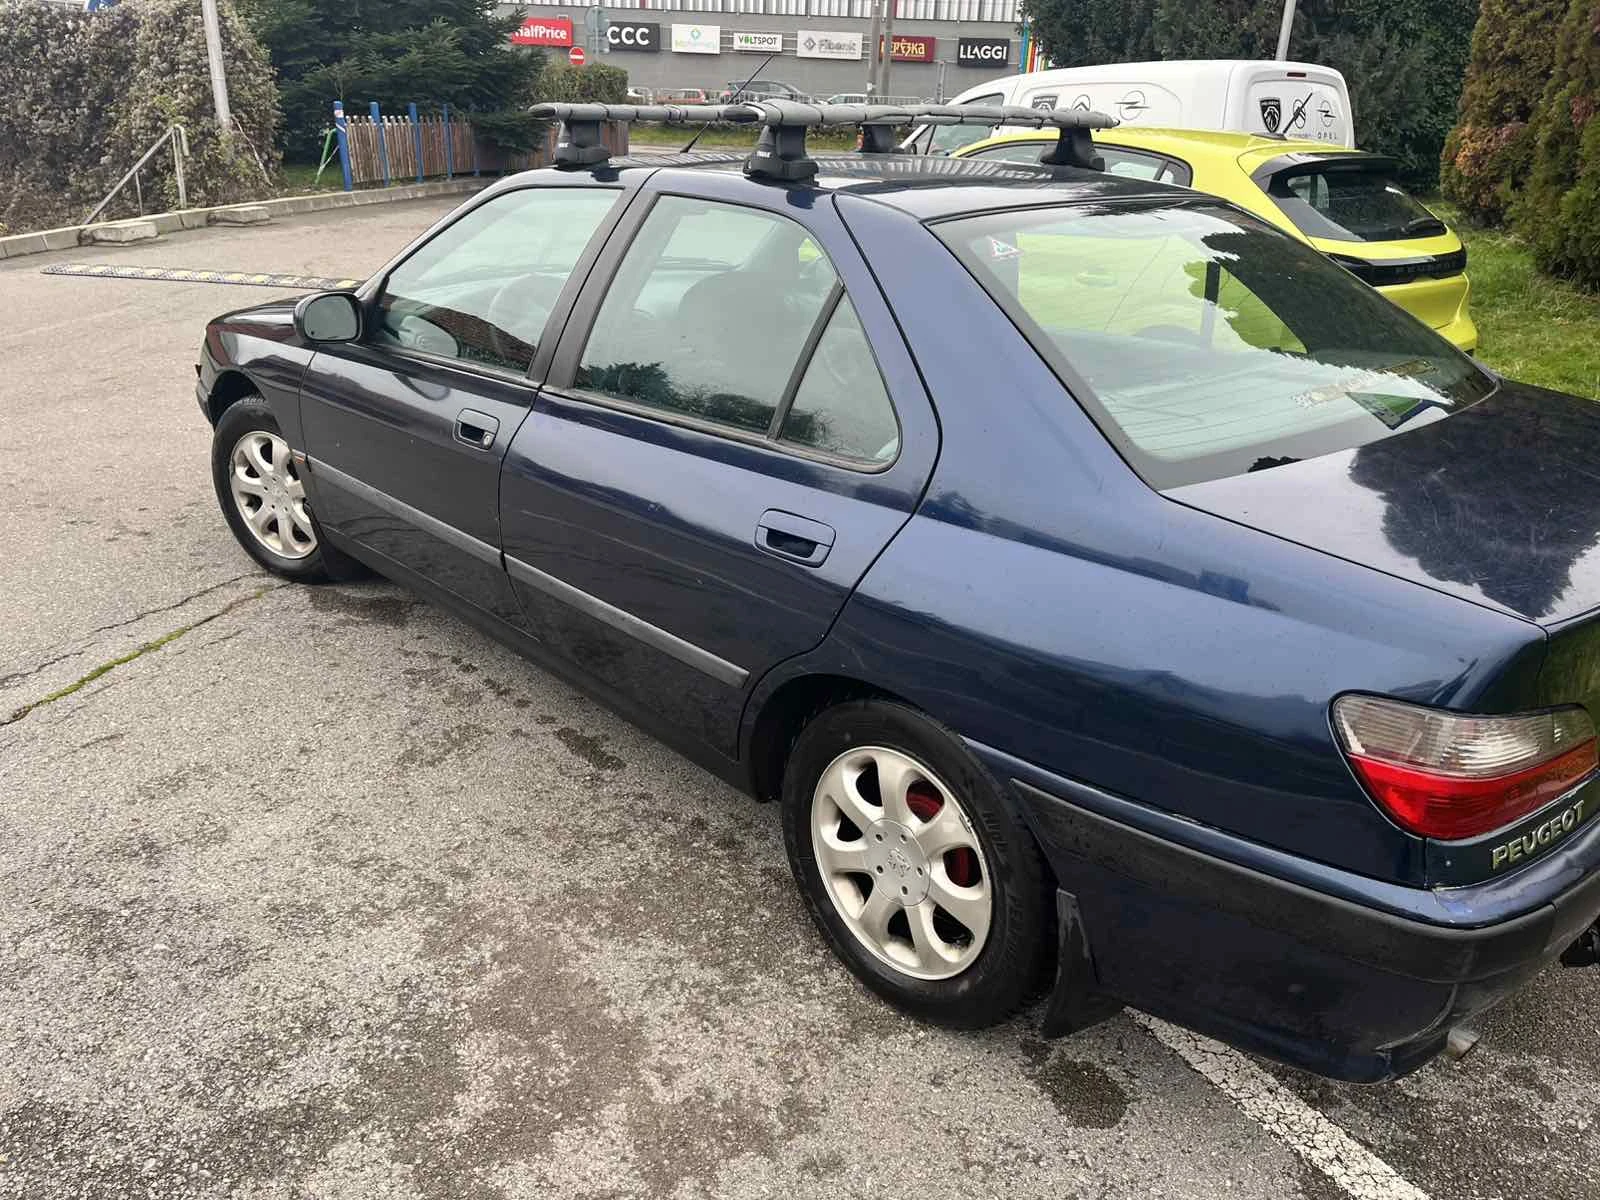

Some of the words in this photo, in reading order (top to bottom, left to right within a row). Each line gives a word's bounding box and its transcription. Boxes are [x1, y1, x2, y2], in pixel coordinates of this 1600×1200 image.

[607, 26, 650, 45] CCC
[738, 36, 777, 45] VOLTSPOT
[959, 45, 1008, 59] LLAGGI
[1492, 799, 1585, 870] PEUGEOT
